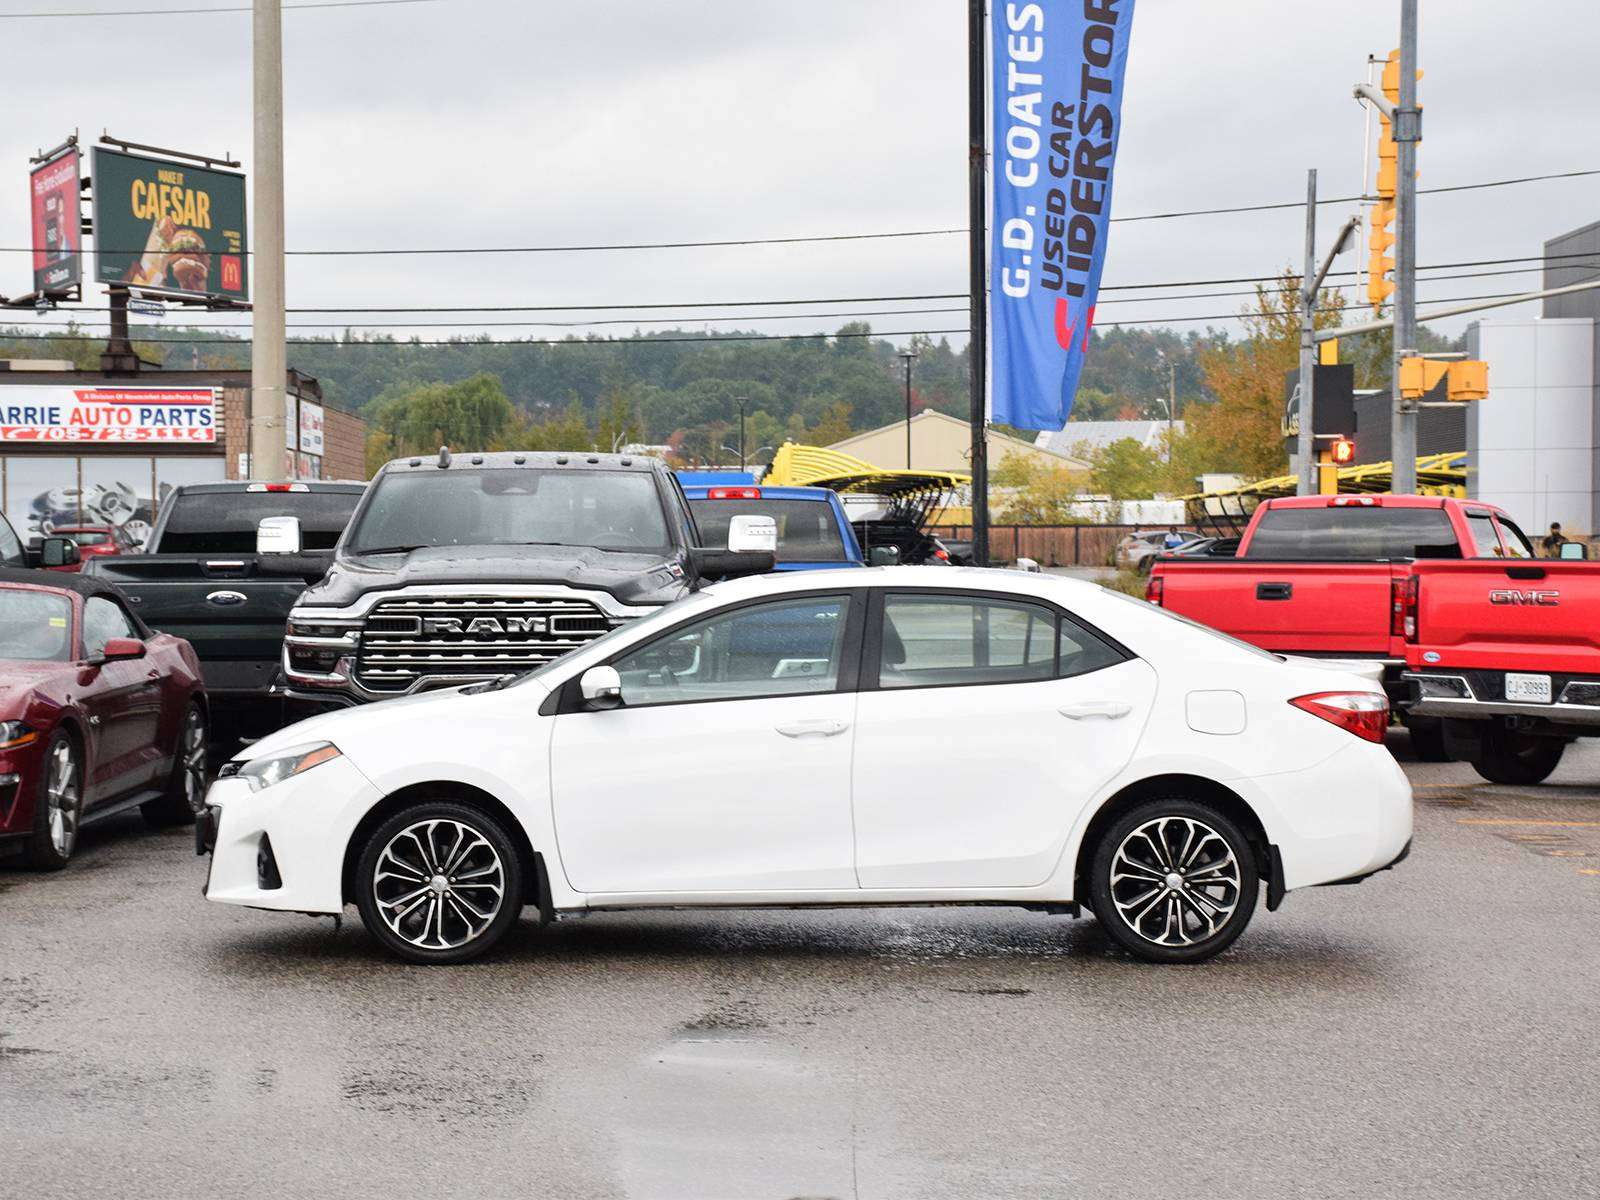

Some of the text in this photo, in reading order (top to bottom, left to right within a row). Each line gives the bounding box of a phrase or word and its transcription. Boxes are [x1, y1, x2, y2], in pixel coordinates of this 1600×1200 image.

[1002, 3, 1044, 298] G.D. COATES
[131, 178, 212, 230] CAESAR
[1041, 101, 1075, 291] USED CAR
[69, 407, 132, 425] AUTO
[140, 408, 212, 426] PARTS
[1488, 589, 1560, 606] GMC
[423, 616, 547, 634] RAM
